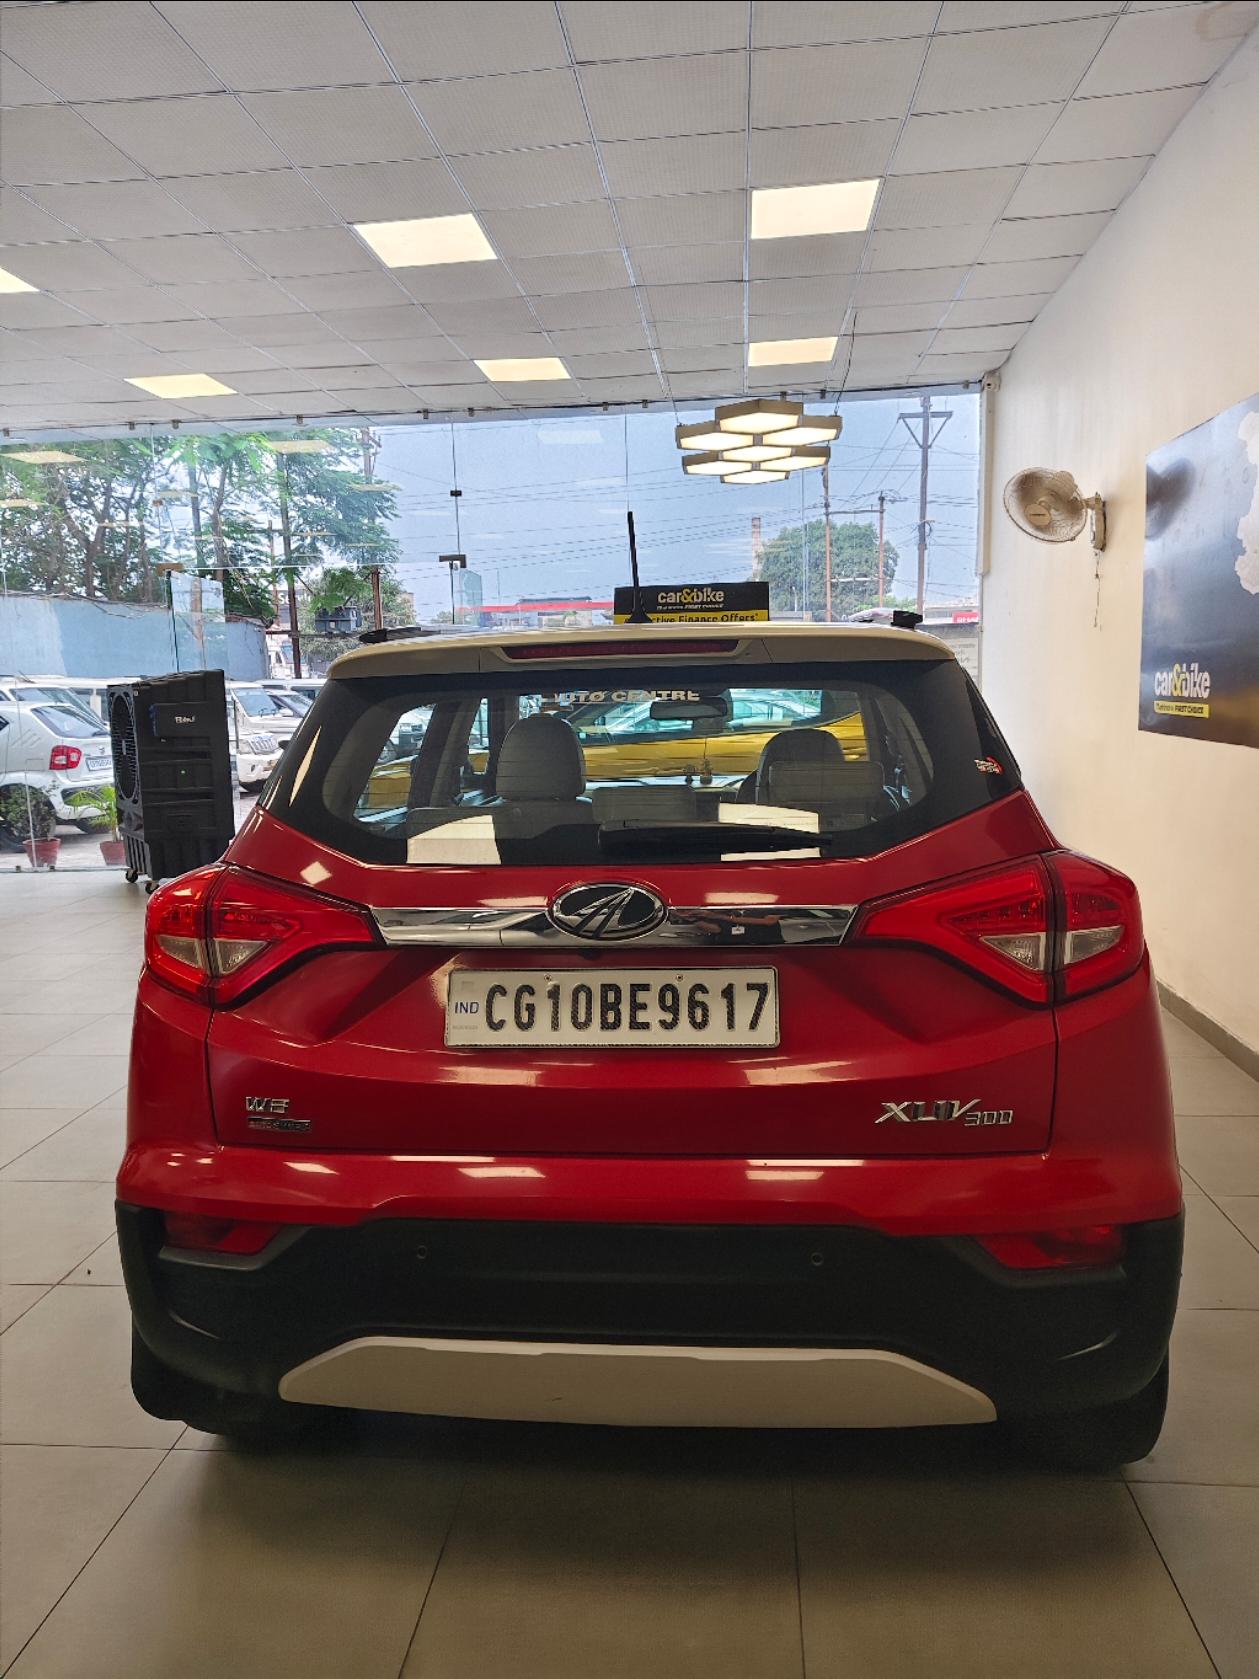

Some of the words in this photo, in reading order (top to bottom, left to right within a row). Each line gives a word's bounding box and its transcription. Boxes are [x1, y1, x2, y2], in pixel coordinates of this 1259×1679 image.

[657, 587, 725, 604] car&bike
[1154, 662, 1211, 699] car&bike
[611, 689, 700, 702] CENTRE
[454, 1001, 480, 1014] IND
[485, 982, 769, 1031] CG10BE9617
